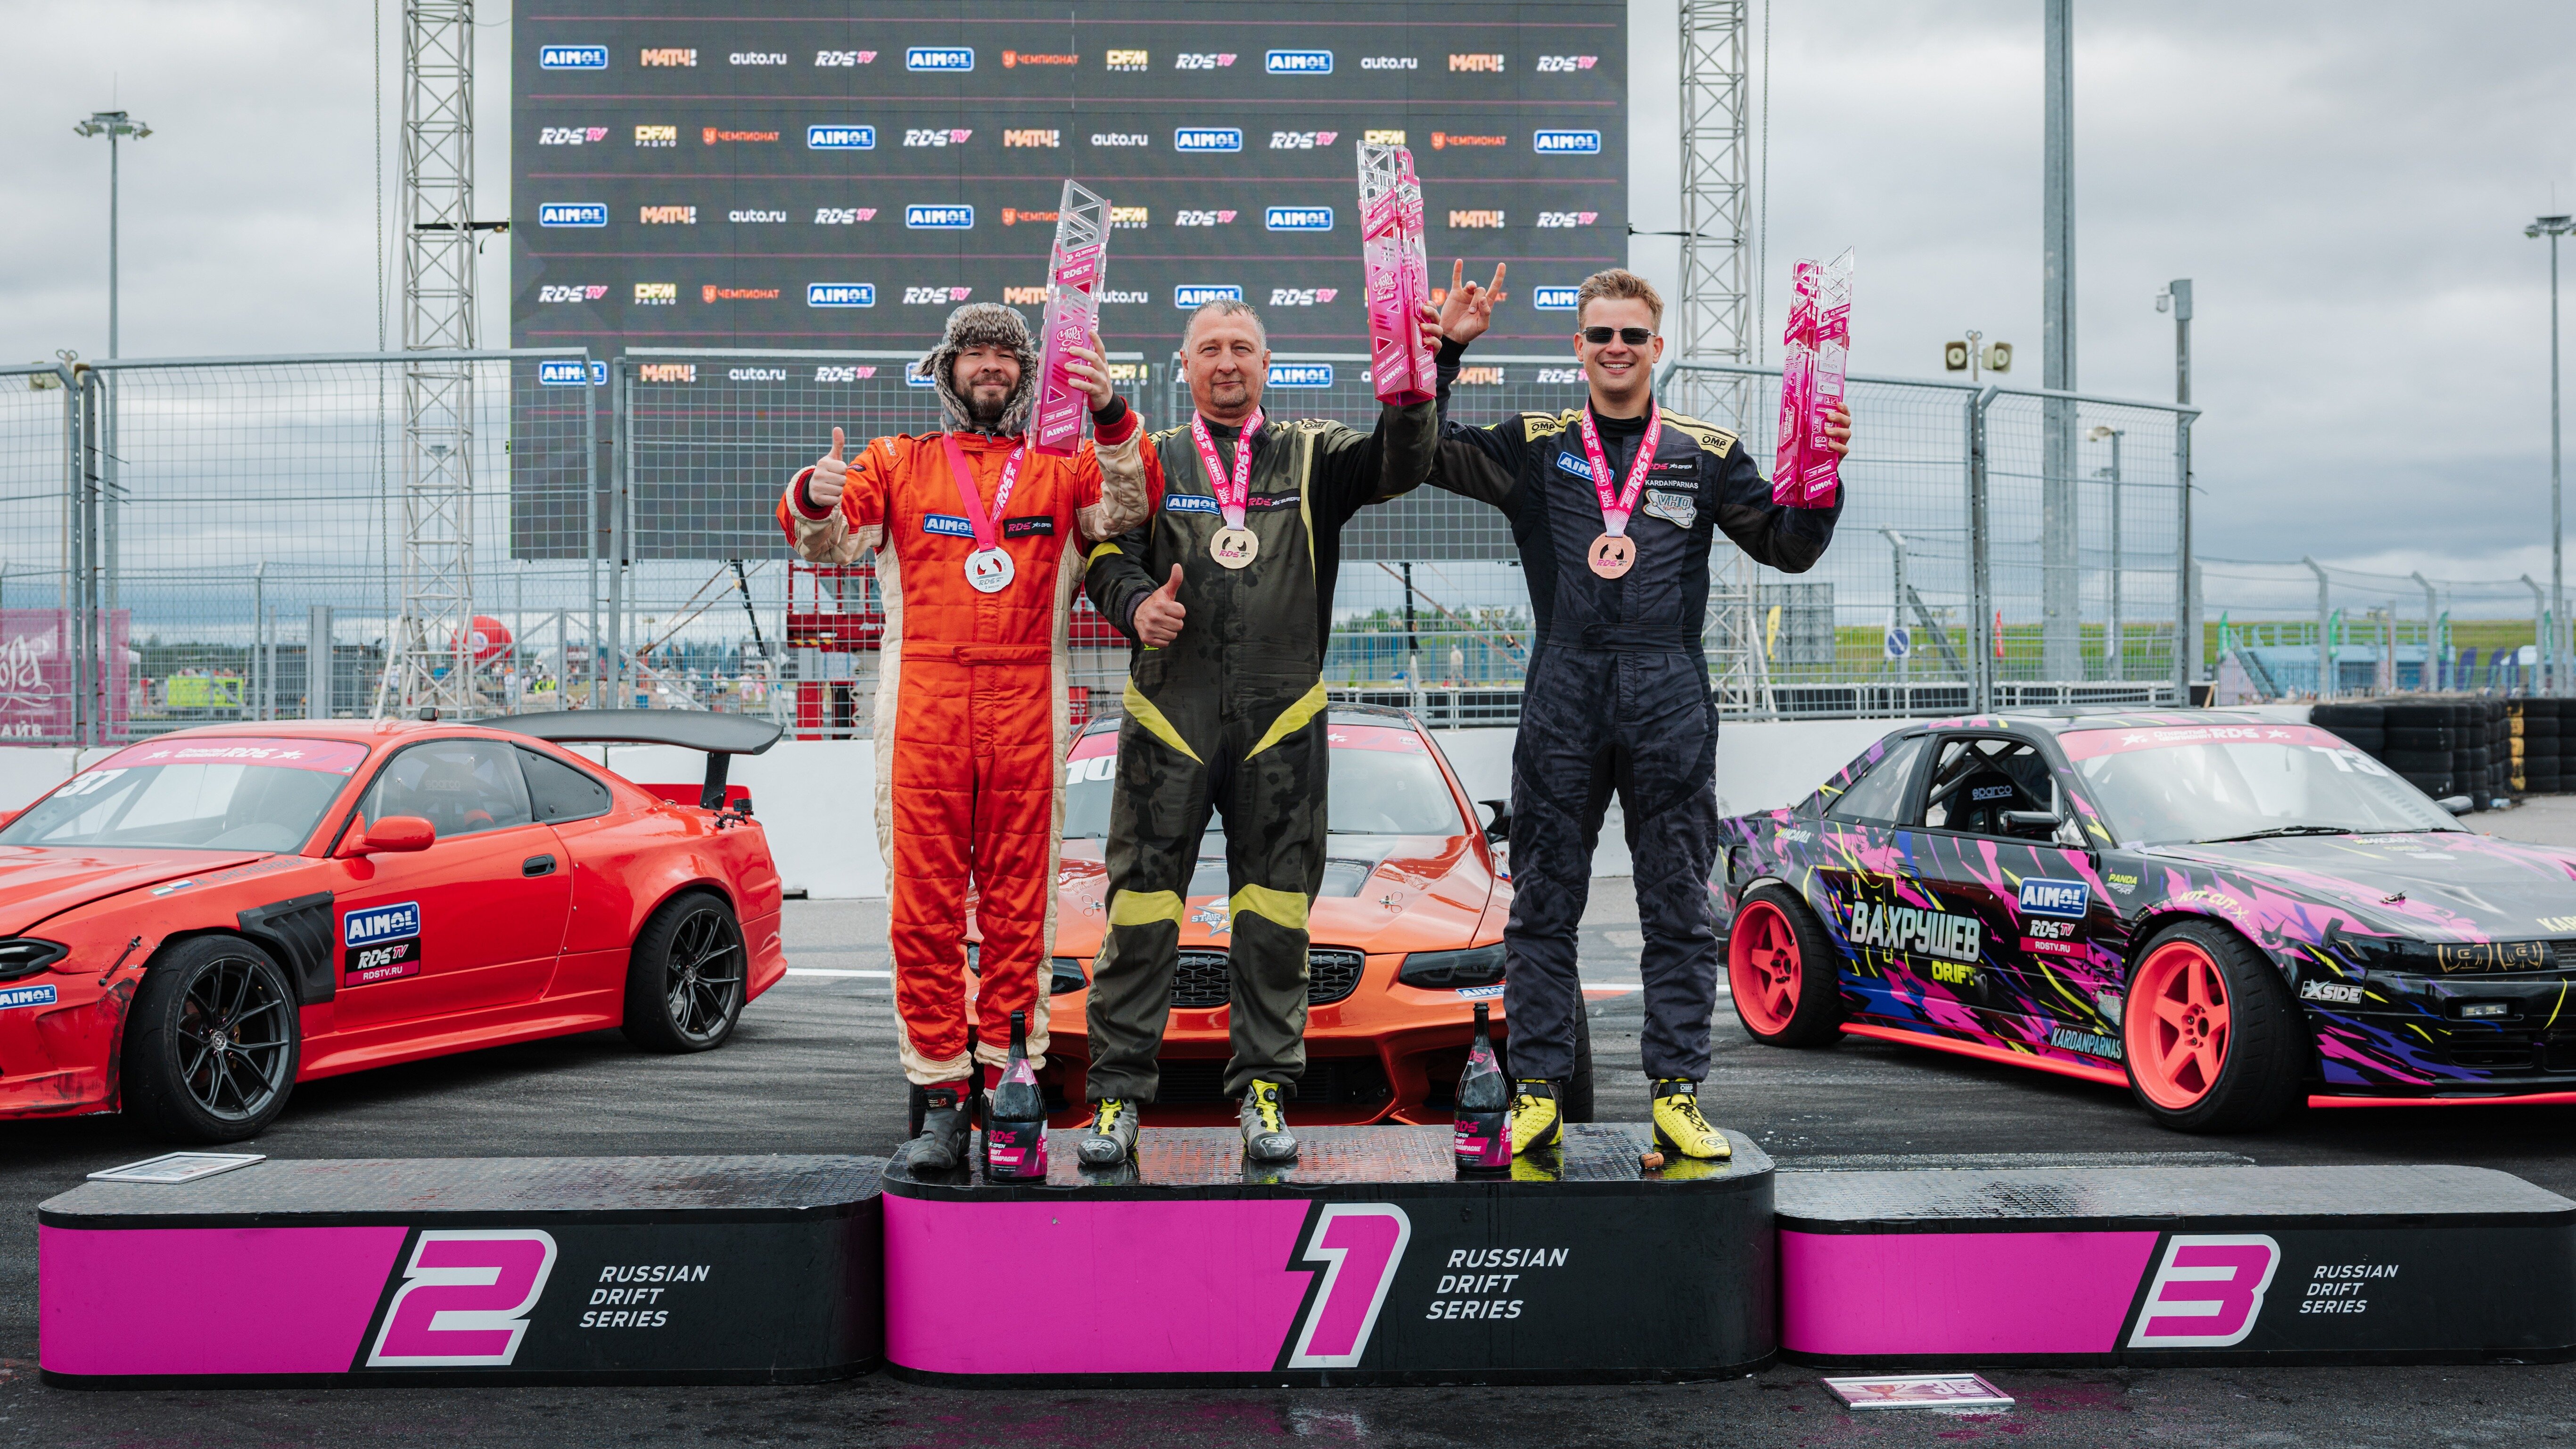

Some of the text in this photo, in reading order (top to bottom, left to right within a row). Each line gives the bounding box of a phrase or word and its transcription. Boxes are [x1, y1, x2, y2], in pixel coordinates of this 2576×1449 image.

[544, 50, 604, 65] AIMOL
[641, 49, 697, 66] МАТЧ!
[729, 52, 787, 65] auto.ru
[910, 52, 971, 67] AIMOL
[1269, 55, 1329, 70] AIMOL
[1361, 57, 1417, 69] auto.ru
[1449, 54, 1504, 72] МАТЧ!
[811, 130, 871, 145] AIMOL
[1004, 130, 1060, 147] МАТЧ!
[1091, 133, 1148, 146] auto.ru
[1178, 132, 1238, 148] AIMOL
[1538, 135, 1597, 149] AIMOL
[543, 208, 604, 222] AIMOL
[641, 206, 696, 224] МАТЧ!
[729, 209, 786, 222] auto.ru
[909, 209, 970, 224] AIMOL
[1017, 213, 1059, 222] ЧЕМПИО
[1269, 212, 1329, 226] AIMOL
[1449, 210, 1504, 228] МАТЧ!
[1063, 266, 1083, 280] RDS
[811, 288, 871, 303] AIMOL
[729, 368, 786, 380] auto.ru
[1270, 369, 1329, 383] AIMOL
[1381, 364, 1404, 386] AIMOL
[1056, 408, 1073, 418] 2026
[1047, 424, 1075, 437] AIMOL
[1193, 419, 1209, 441] RDS
[1531, 422, 1555, 432] OMP
[1582, 413, 1596, 439] RDS
[1648, 420, 1658, 444] AIMOL
[1702, 436, 1727, 447] OMP
[1208, 457, 1222, 483] AIMOL
[1235, 453, 1249, 485] RDS
[1593, 457, 1606, 484] AIMOL
[1628, 457, 1648, 491] RDS
[996, 473, 1014, 509] RDS
[1645, 480, 1698, 489] KARDANPARNAS
[1775, 475, 1792, 493] AIMOL
[1810, 479, 1833, 494] AIMOL
[1218, 488, 1229, 504] 2026
[1248, 497, 1272, 507] RDS
[1600, 490, 1610, 508] 2026
[1619, 487, 1629, 508] RUSSIAN
[1658, 495, 1692, 510] VHQ
[1169, 497, 1218, 512] AIMOL
[926, 519, 972, 532] AIMO
[1008, 522, 1031, 532] RDS
[1219, 550, 1240, 558] RDS
[2209, 728, 2259, 739] RDS
[54, 768, 129, 798] 37
[213, 857, 305, 881] SHCHERBAK
[2108, 873, 2138, 885] PANDA
[2021, 885, 2083, 909] AIMOL
[2177, 890, 2239, 910] KIT CUT
[349, 910, 416, 940] AIMOL
[1191, 913, 1223, 922] STAR
[1850, 901, 1980, 963] ВАХРУШЕВ
[2035, 941, 2071, 953] RDSTV.RU
[363, 966, 403, 980] RDSTV.RU
[1932, 960, 1976, 986] DRIFT
[0, 989, 54, 1005] AIMOL
[2305, 979, 2361, 1001] XSIDE
[2050, 1027, 2122, 1060] KARDANPARNAS
[1455, 1120, 1481, 1133] RDS
[989, 1130, 1018, 1144] RDS
[1447, 1249, 1569, 1268] RUSSIAN
[599, 1266, 710, 1282] RUSSIAN
[2314, 1265, 2398, 1278] RUSSIAN
[1288, 1202, 1411, 1368] 1
[1437, 1275, 1519, 1293] DRIFT
[2127, 1234, 2281, 1348] 3
[2307, 1283, 2364, 1295] DRIFT
[368, 1229, 557, 1366] 2
[590, 1288, 664, 1304] DRIFT
[1426, 1300, 1523, 1319] SERIES
[2299, 1300, 2367, 1313] SERIES
[580, 1311, 668, 1327] SERIES
